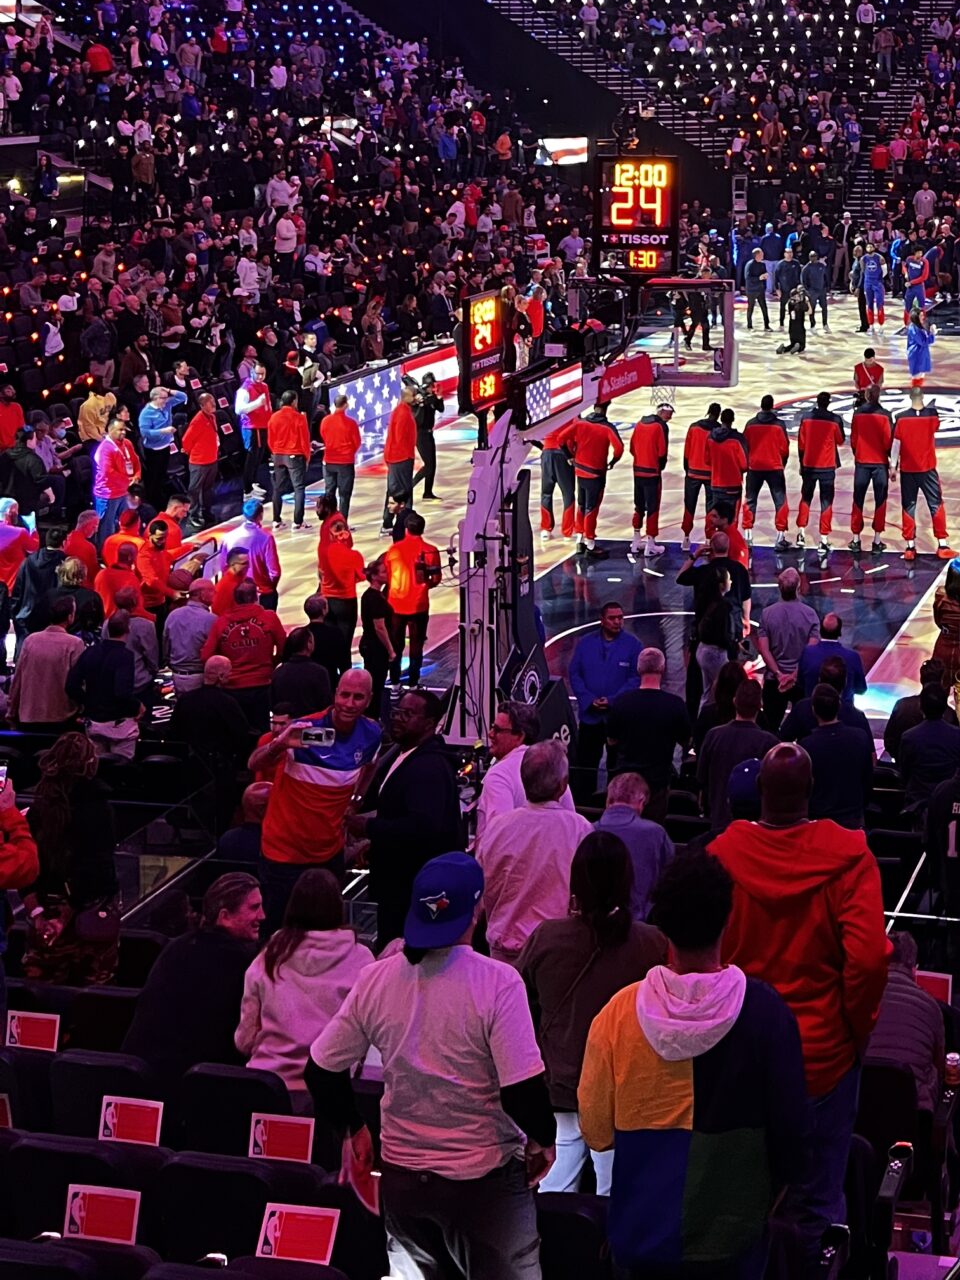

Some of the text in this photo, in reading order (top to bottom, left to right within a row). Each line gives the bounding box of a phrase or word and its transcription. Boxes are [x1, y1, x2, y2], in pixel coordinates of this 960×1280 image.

[615, 163, 667, 187] 12:00
[611, 186, 662, 226] 24
[620, 234, 669, 245] TISSOT
[629, 250, 657, 268] 1:30
[474, 322, 492, 350] 24
